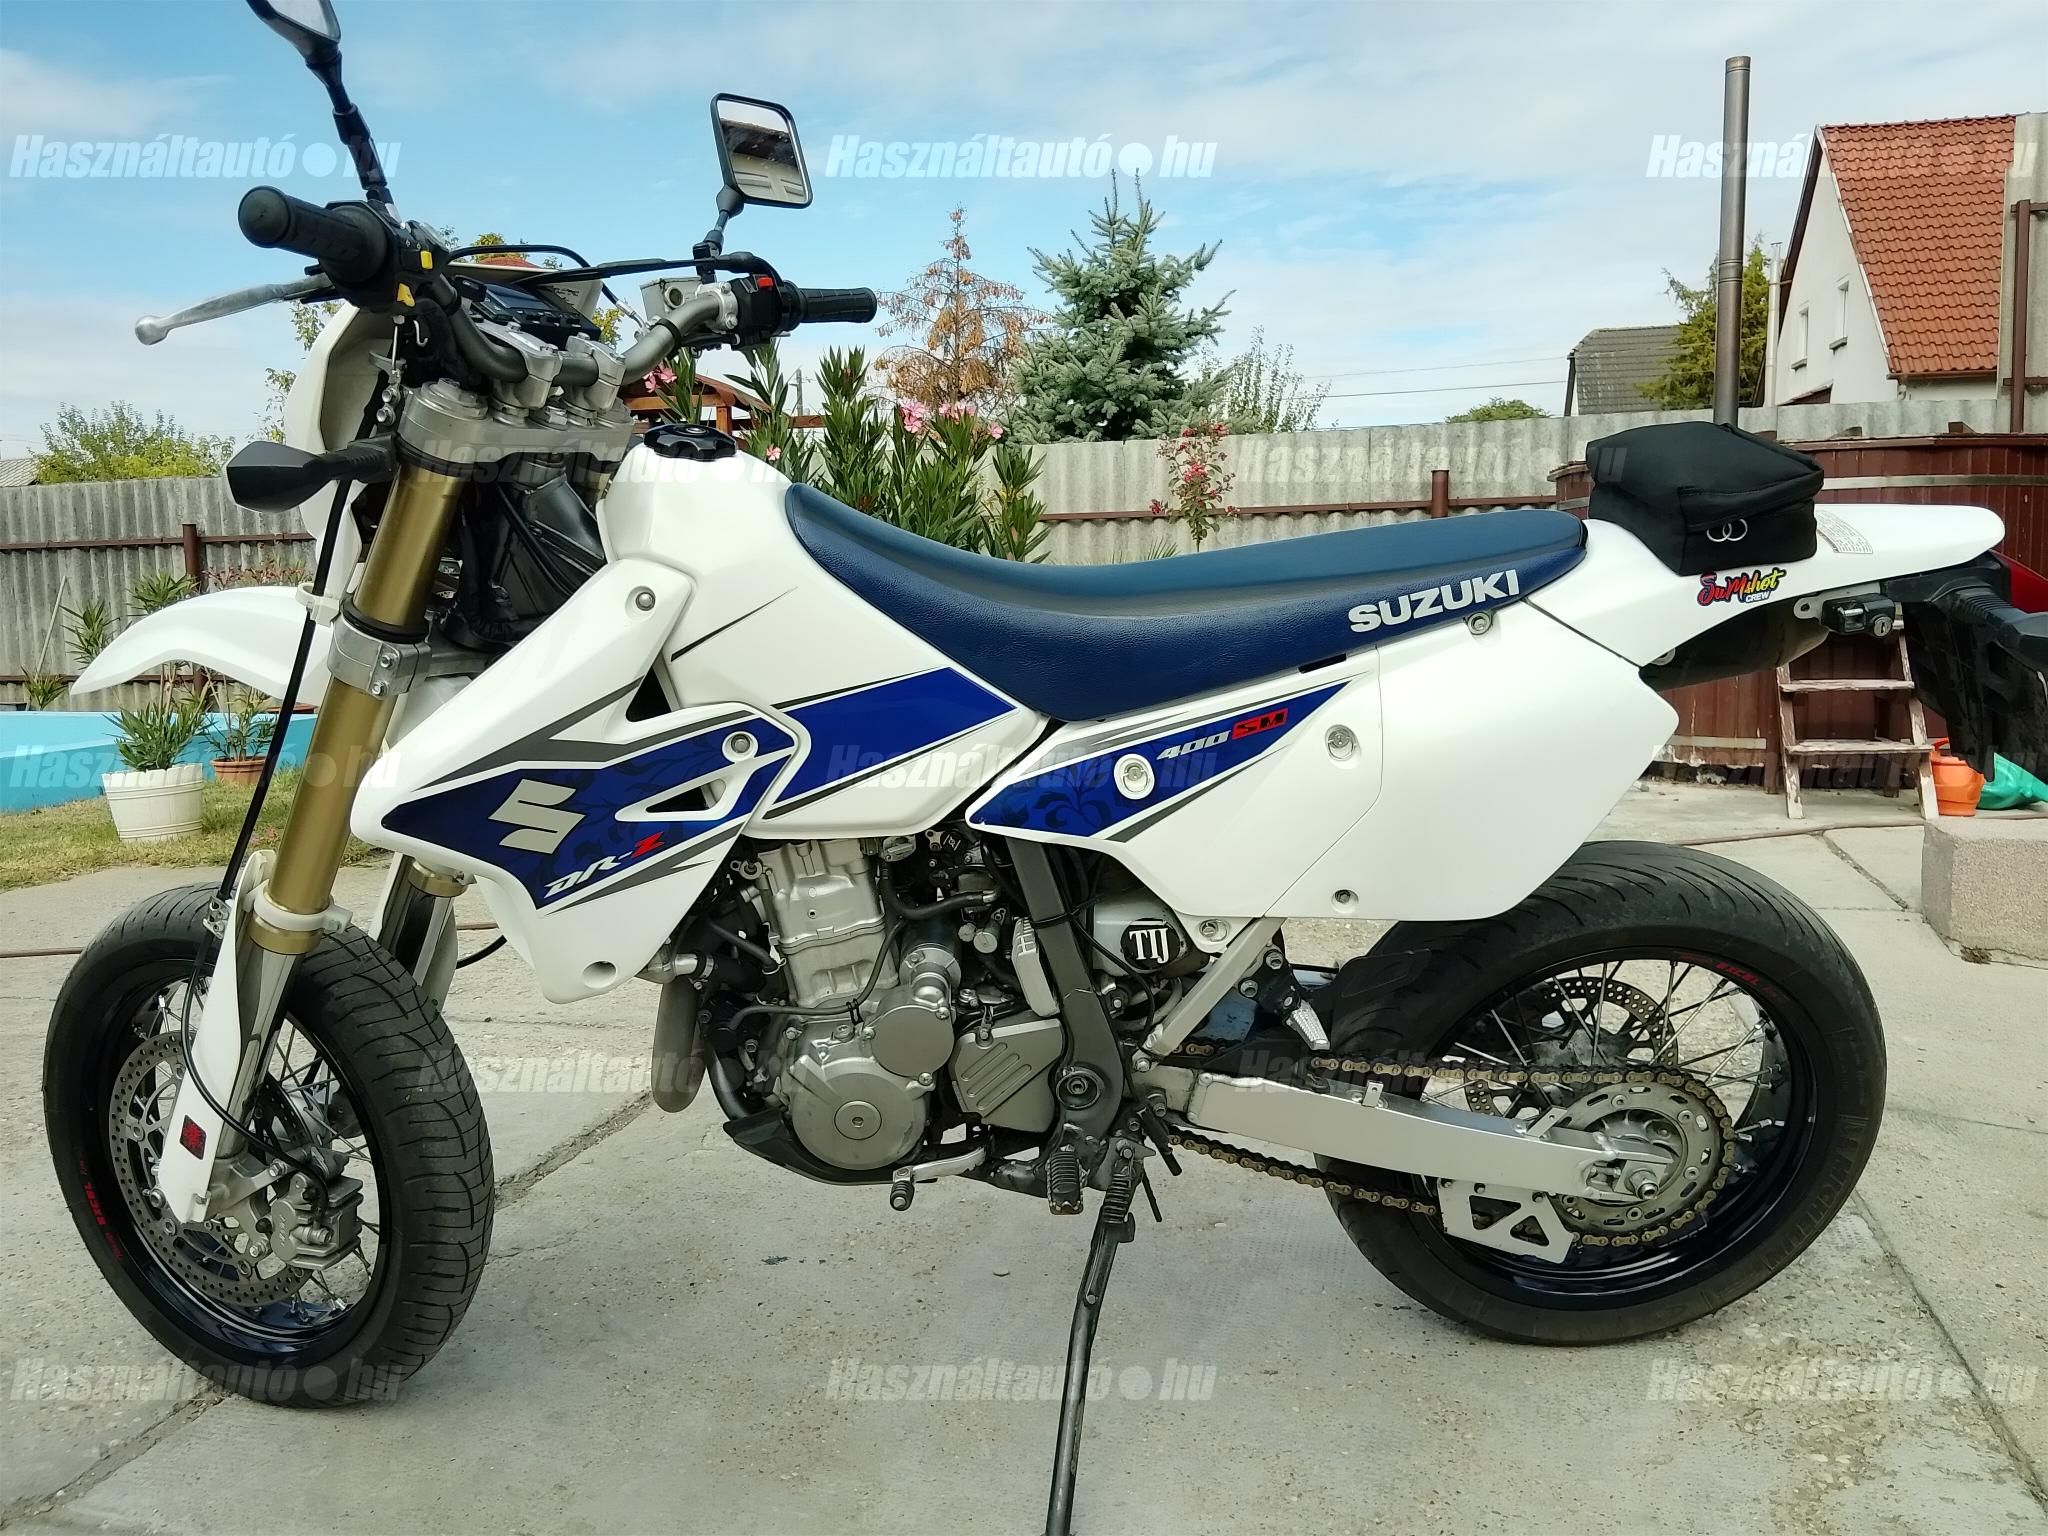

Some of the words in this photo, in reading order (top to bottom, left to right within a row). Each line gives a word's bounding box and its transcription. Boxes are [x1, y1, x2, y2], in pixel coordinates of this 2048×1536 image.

[1348, 569, 1520, 633] SUZUKI
[1744, 590, 1772, 603] CREW
[1156, 730, 1231, 760] 400
[1235, 711, 1286, 736] SM
[543, 831, 665, 899] DR-Z
